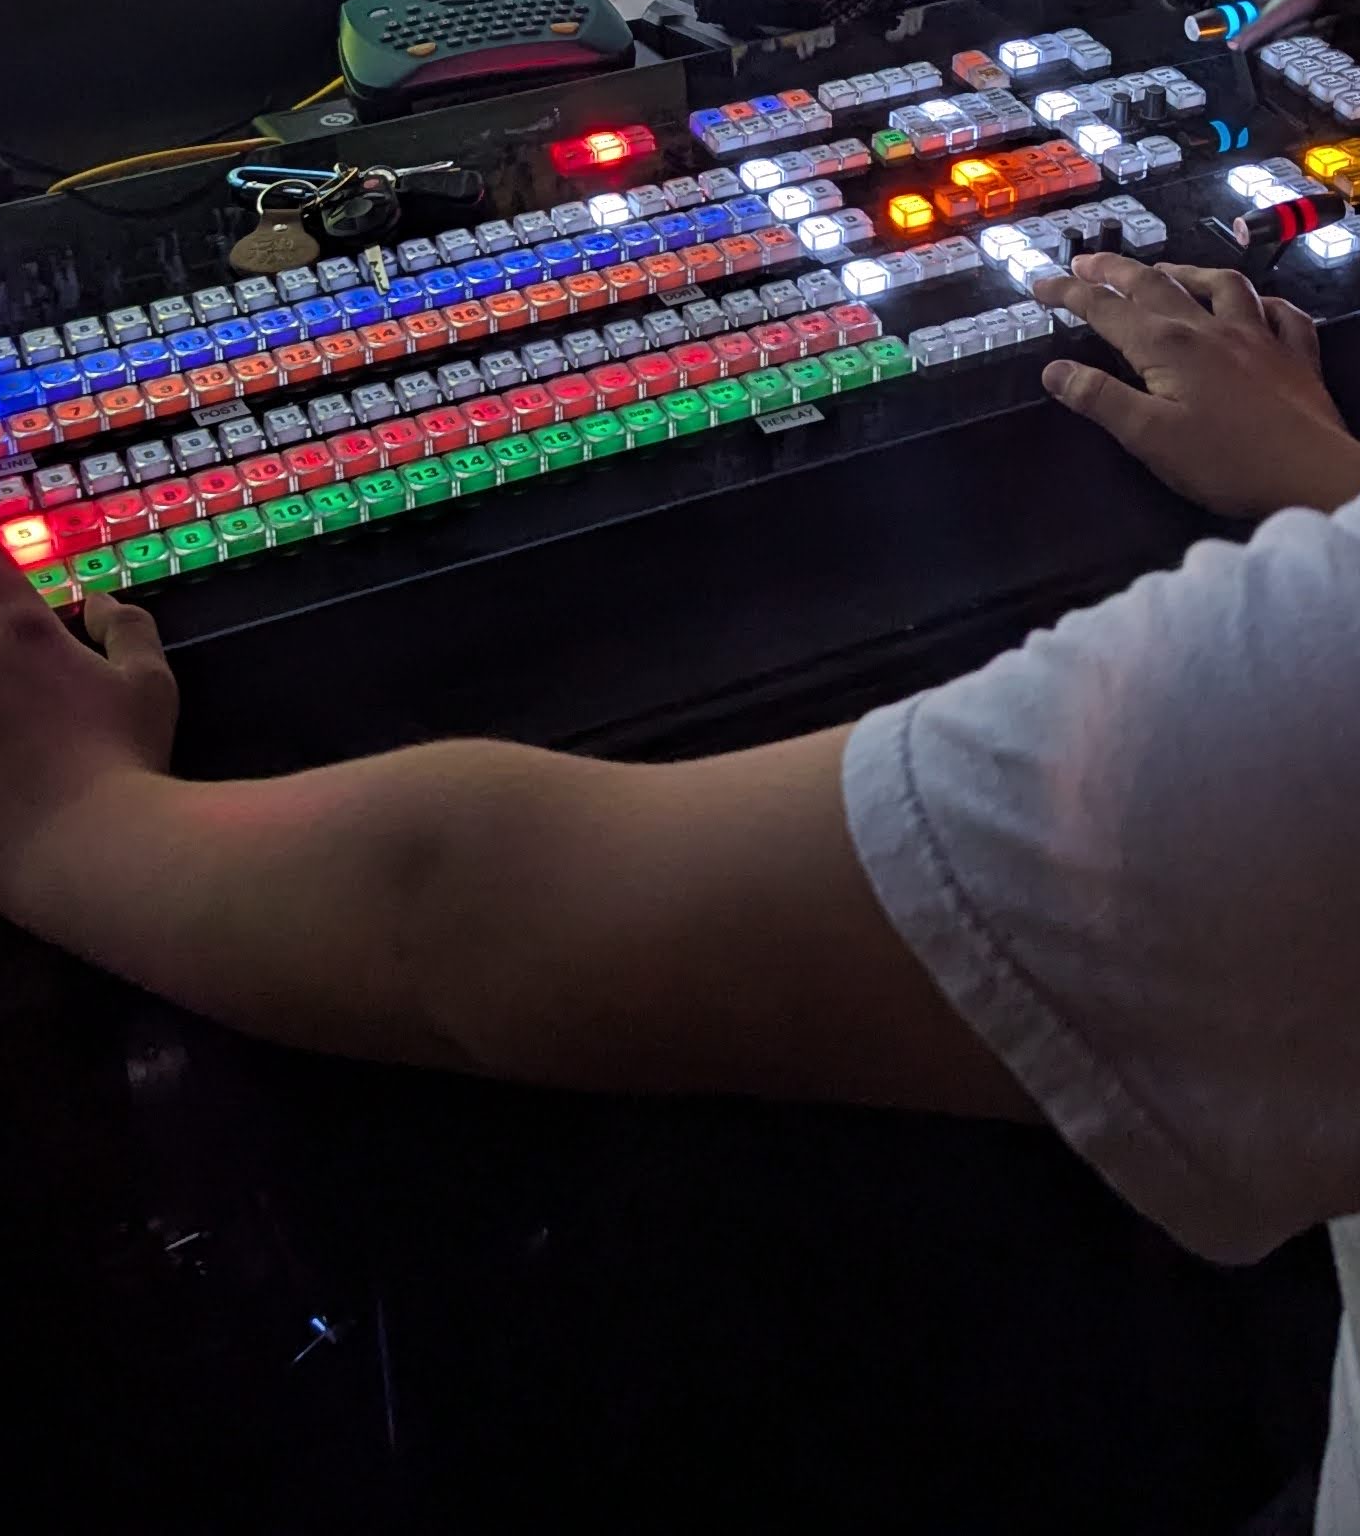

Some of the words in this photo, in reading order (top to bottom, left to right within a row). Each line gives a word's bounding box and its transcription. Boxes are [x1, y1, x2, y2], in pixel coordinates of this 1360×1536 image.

[198, 402, 239, 421] POST
[760, 406, 817, 430] REPLAY
[275, 503, 305, 520] 10
[365, 479, 397, 494] 12
[408, 467, 440, 481] 13
[455, 454, 487, 469] 14
[498, 443, 529, 458] 15
[542, 430, 574, 446] 16
